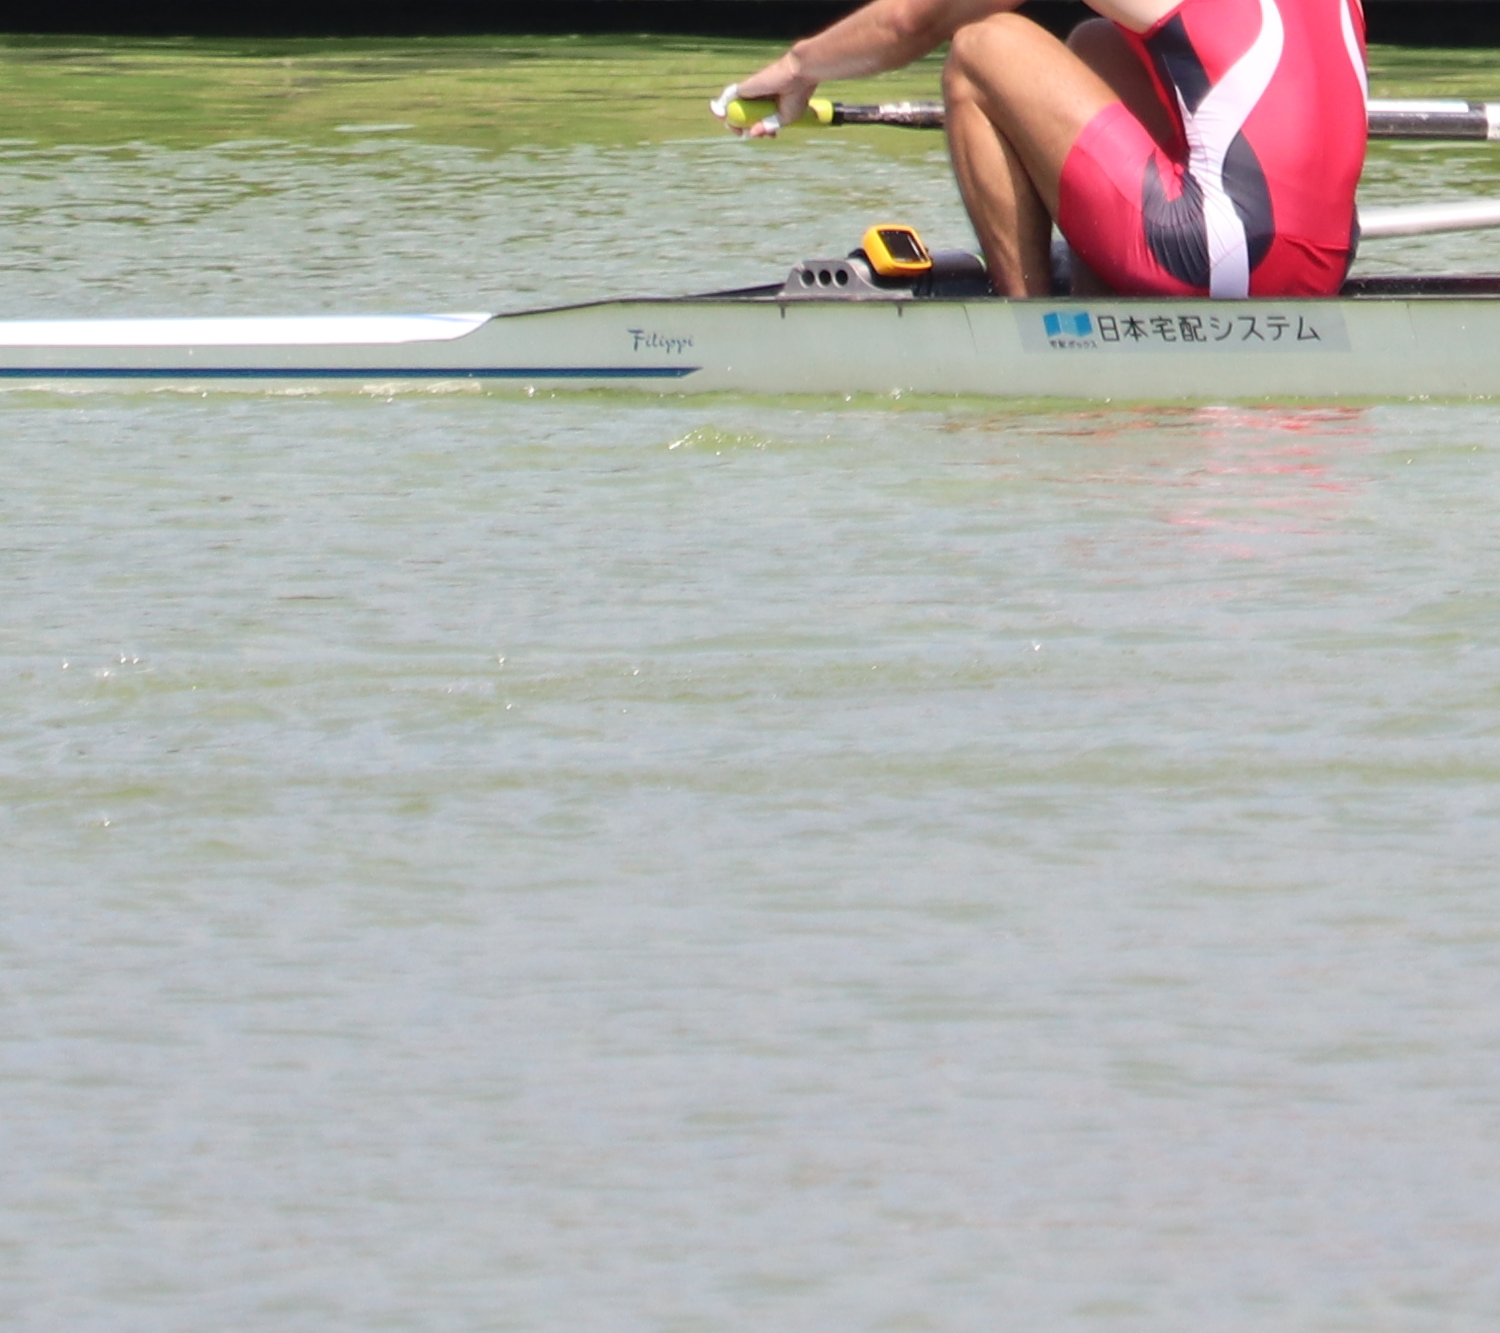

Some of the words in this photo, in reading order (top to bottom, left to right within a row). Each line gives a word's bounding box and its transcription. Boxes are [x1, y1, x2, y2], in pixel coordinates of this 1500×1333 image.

[627, 329, 694, 354] Filippi
[1097, 315, 1321, 342] 日本宅配システム
